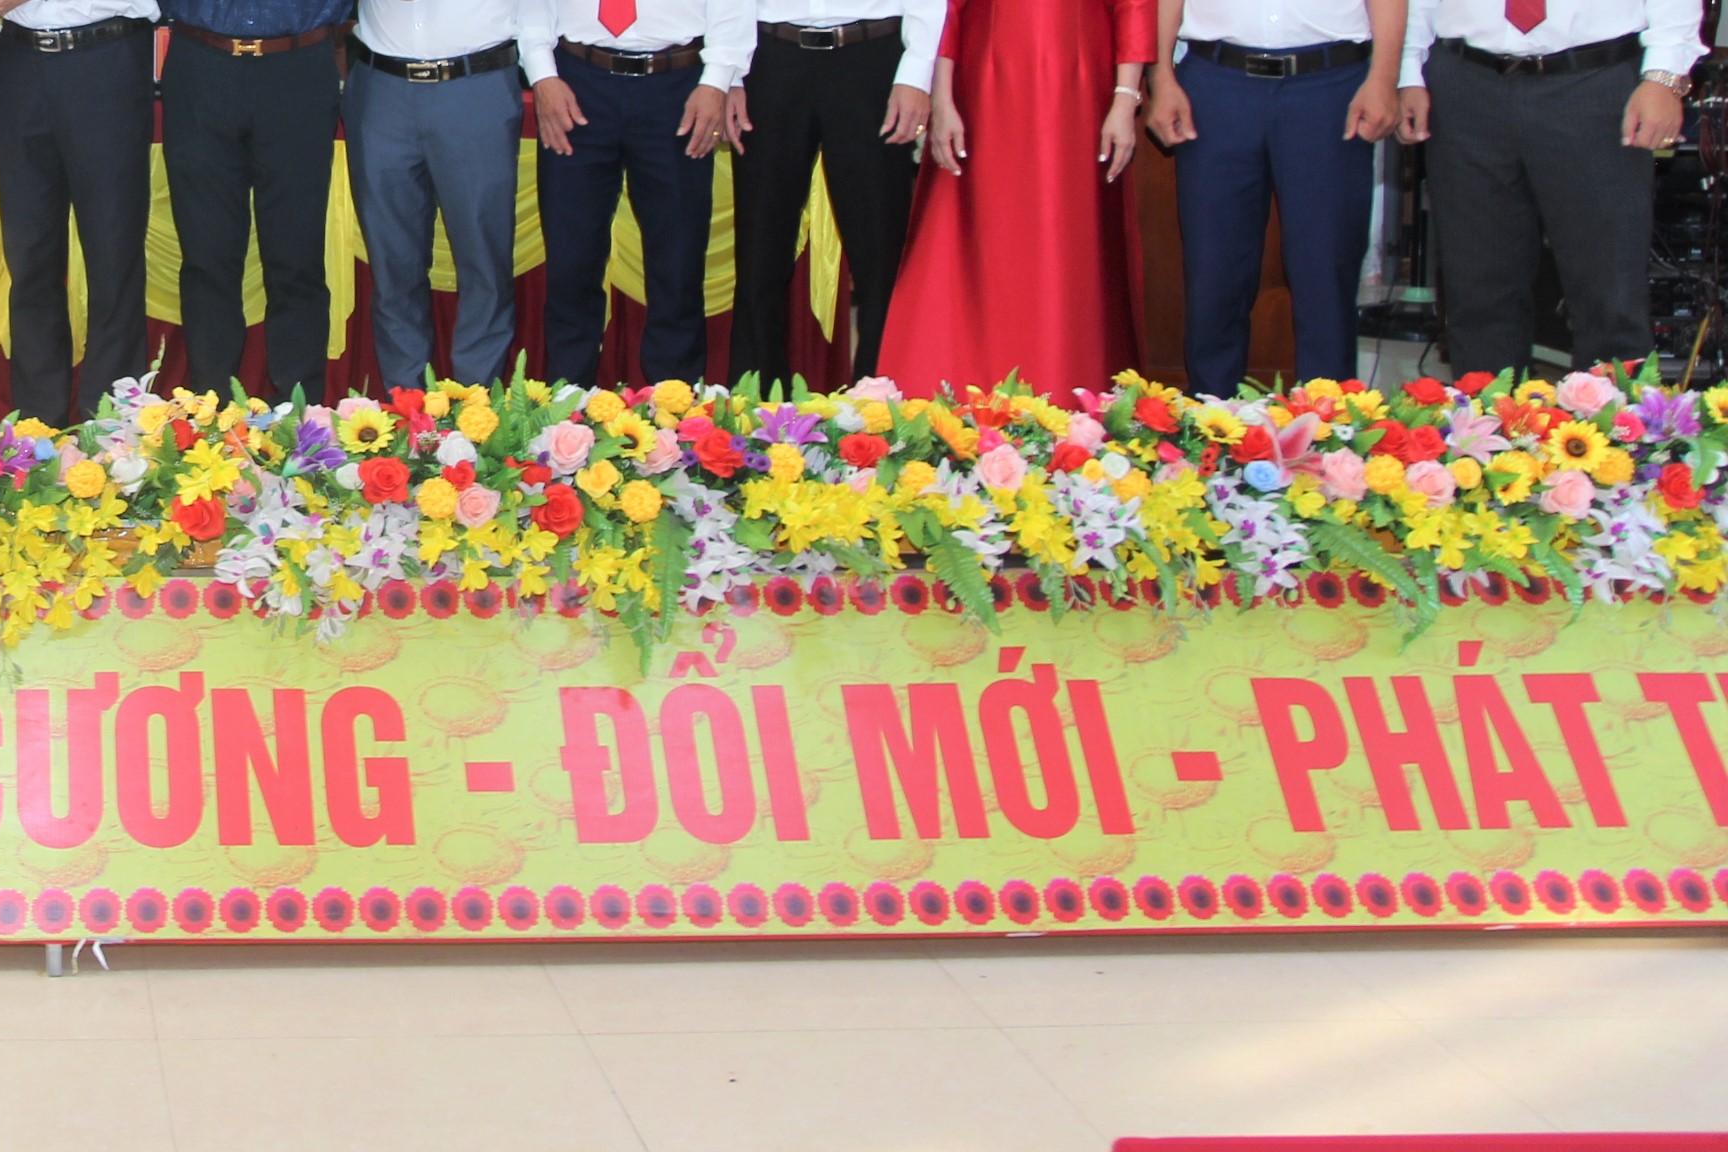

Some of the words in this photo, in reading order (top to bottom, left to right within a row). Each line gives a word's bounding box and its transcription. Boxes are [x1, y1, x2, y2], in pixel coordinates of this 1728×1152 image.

[558, 621, 811, 846] ĐỔI
[841, 645, 1136, 840] MỚI
[1250, 640, 1629, 833] PHÁT
[1635, 672, 1728, 828] T
